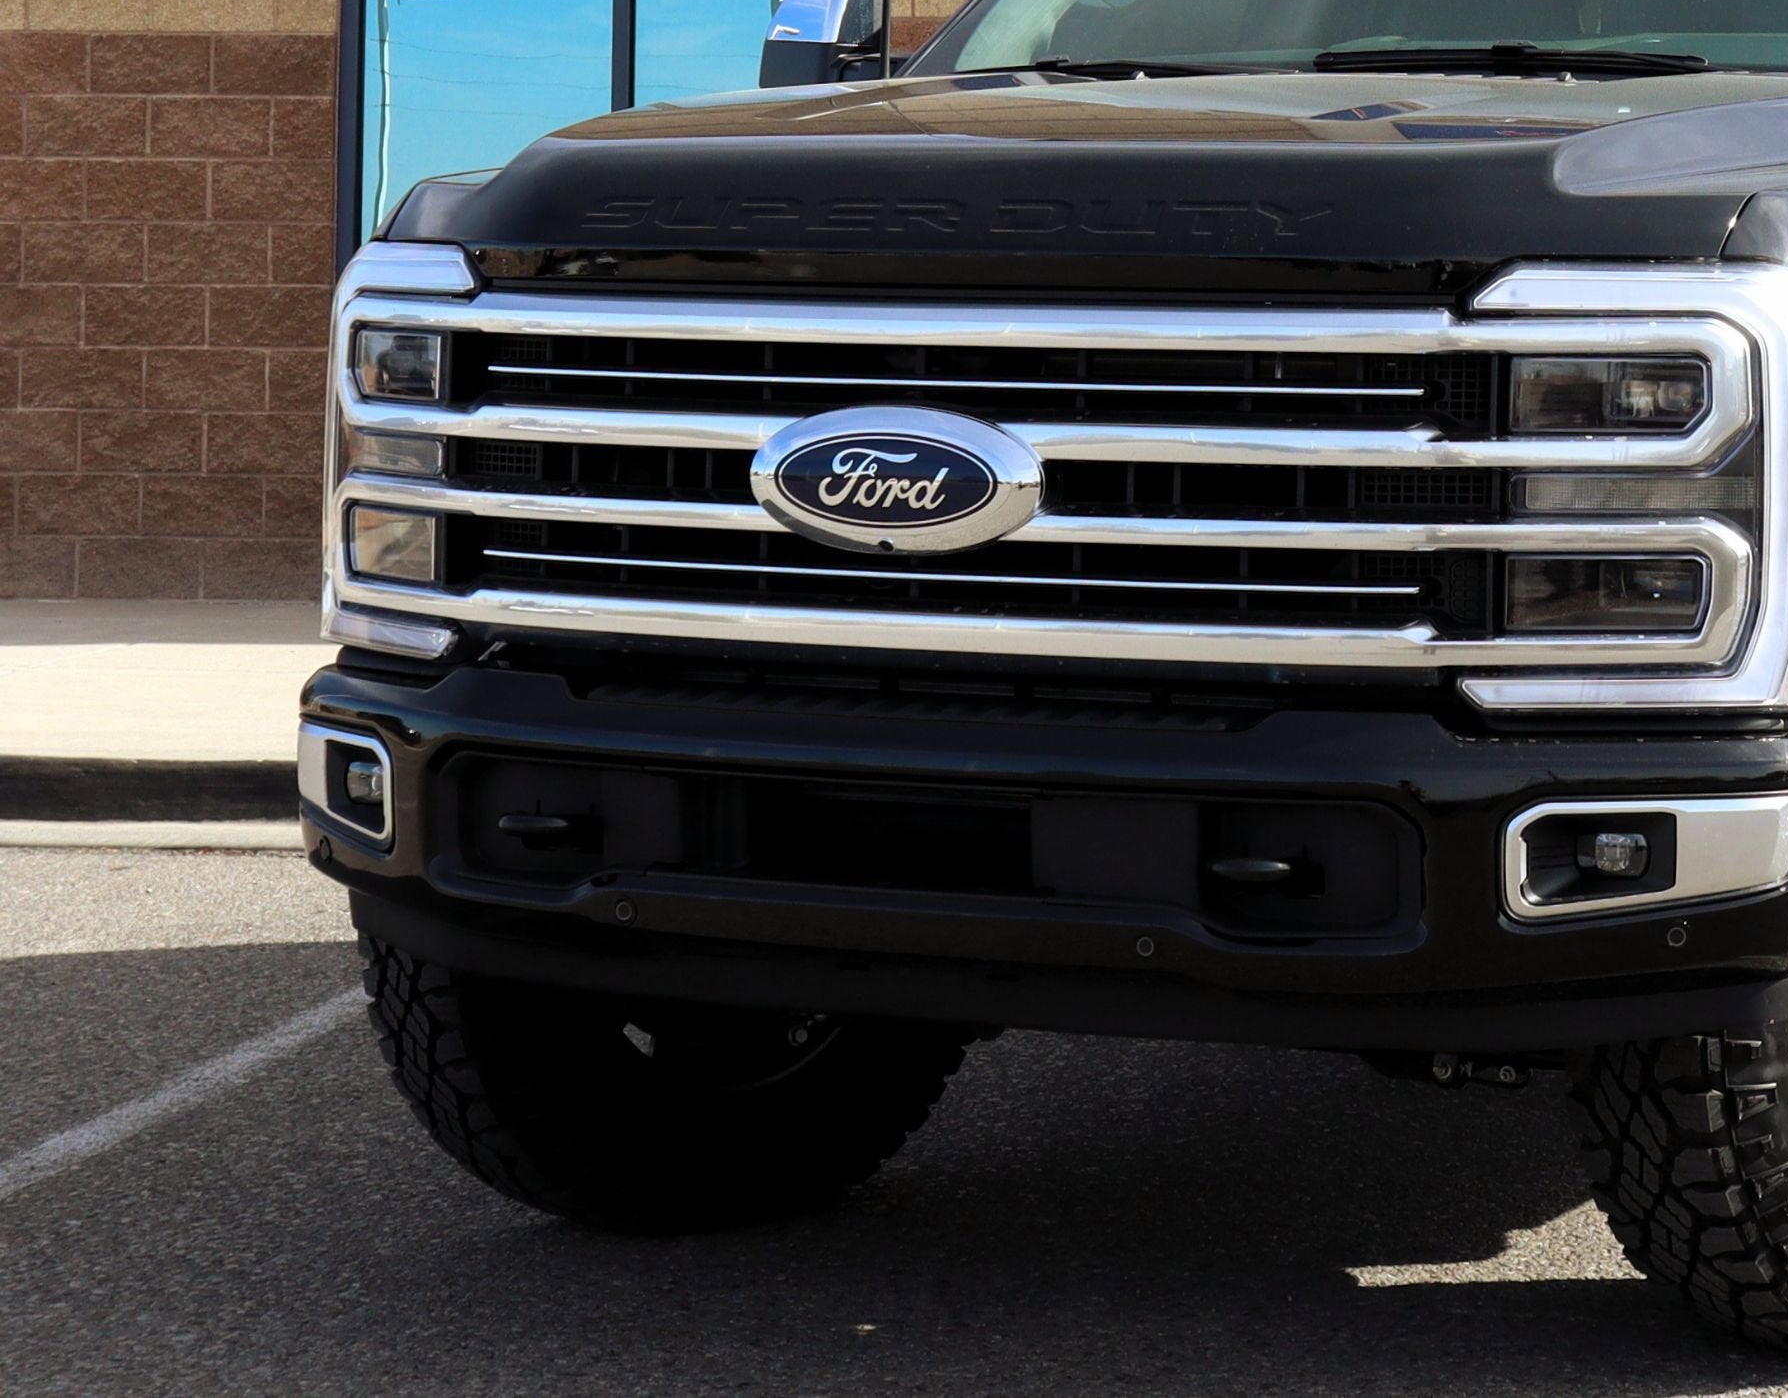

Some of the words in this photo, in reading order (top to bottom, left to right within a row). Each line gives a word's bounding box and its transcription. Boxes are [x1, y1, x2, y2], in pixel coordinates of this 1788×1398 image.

[580, 195, 963, 234] SUPER
[991, 198, 1336, 237] DUTY
[818, 447, 950, 510] Ford
